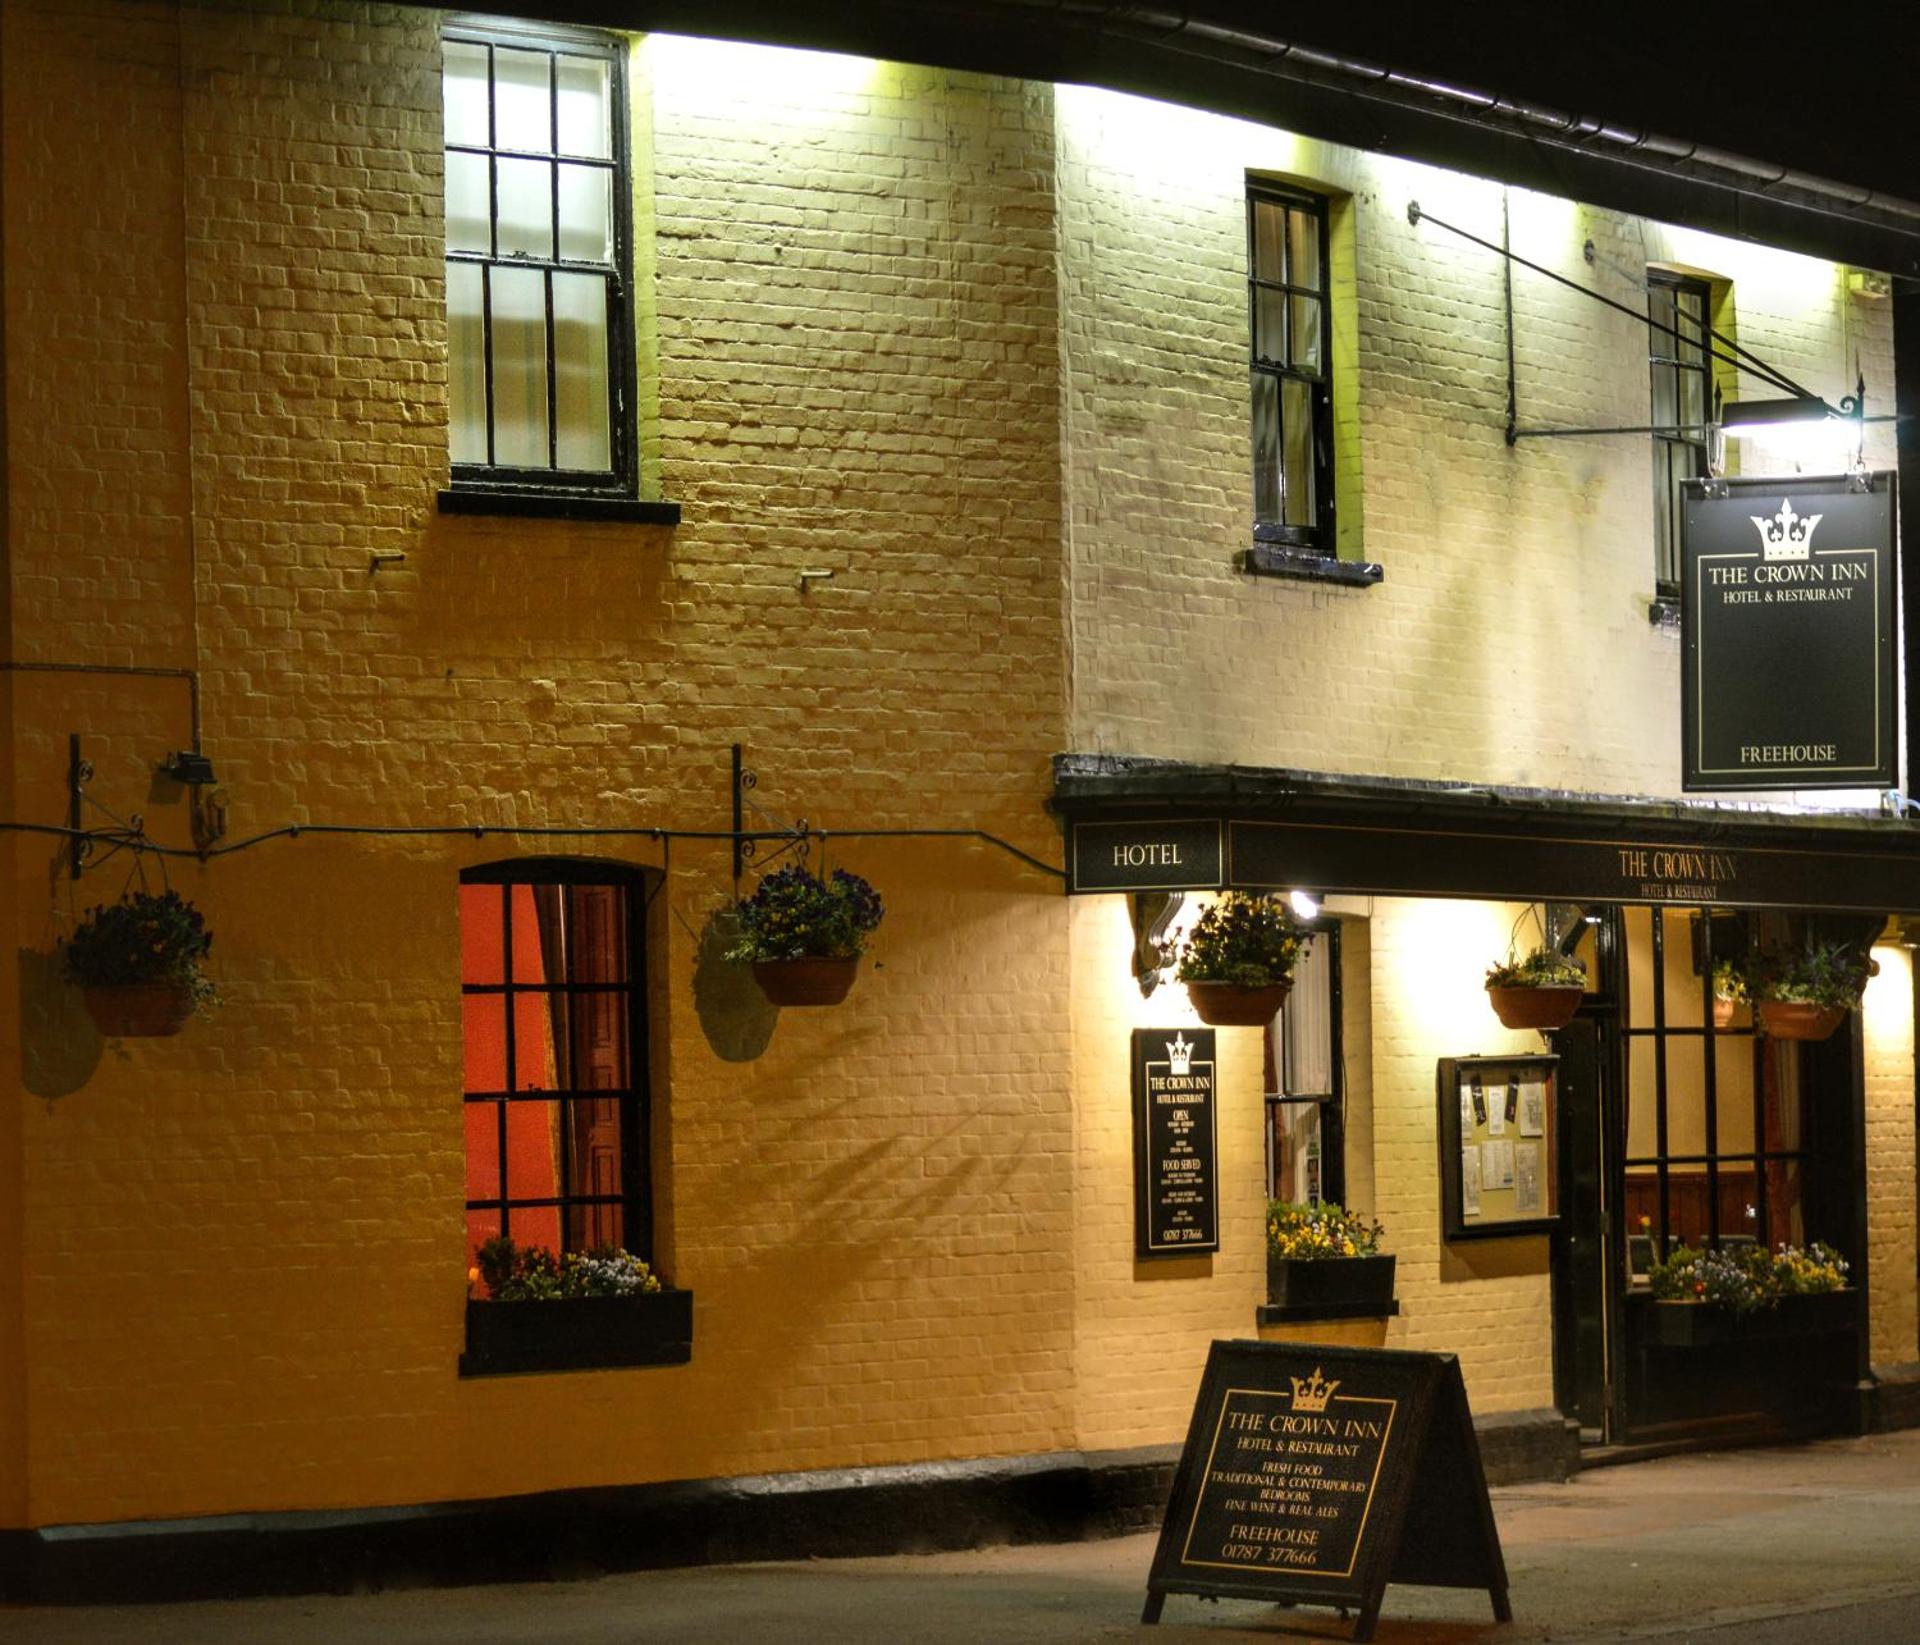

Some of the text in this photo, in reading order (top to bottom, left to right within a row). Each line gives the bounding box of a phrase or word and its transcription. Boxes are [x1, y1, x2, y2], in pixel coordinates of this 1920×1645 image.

[1709, 563, 1868, 585] THE CROWN INN
[1723, 588, 1853, 604] HOTEL & RESTAURANT
[1740, 745, 1837, 763] FREEHOUSE
[1113, 844, 1182, 866] HOTEL
[1618, 850, 1737, 881] THE CROWN INN
[1641, 883, 1718, 899] HOTEL & RESTAURANT
[1150, 1076, 1211, 1091] THE CROWN INN
[1162, 1158, 1202, 1171] FOOD SERVED
[1229, 1412, 1382, 1438] THE CROWN INN
[1237, 1437, 1360, 1457] HOTEL & RESTAURANT
[1262, 1461, 1323, 1476] FRESH FOOD
[1211, 1471, 1366, 1493] TRADITIONAL & CONTEMPORARY
[1260, 1488, 1311, 1501] BEDROOMS
[1225, 1499, 1340, 1518] FINE WINE & REAL ALES
[1230, 1524, 1319, 1545] FREEHOUSE
[1222, 1544, 1317, 1565] 01787 377666
